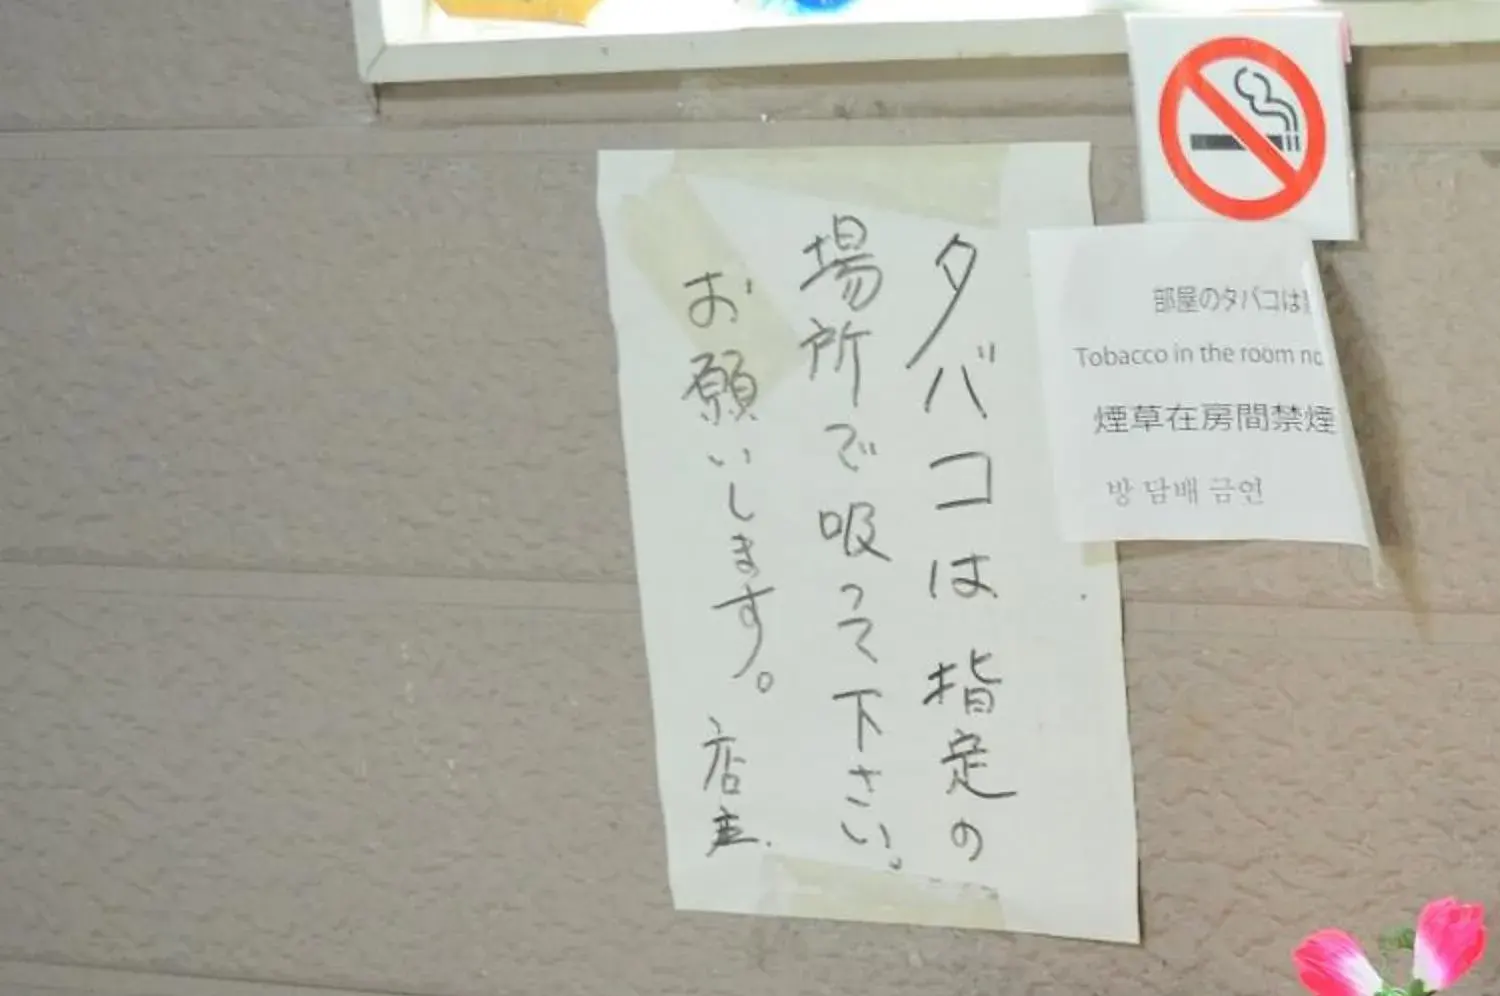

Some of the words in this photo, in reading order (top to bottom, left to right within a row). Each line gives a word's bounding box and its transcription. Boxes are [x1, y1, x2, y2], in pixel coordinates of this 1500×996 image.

[1152, 285, 1310, 314] 部屋のタバコは
[1074, 346, 1168, 368] Tobacco
[1174, 342, 1194, 365] in
[1200, 343, 1234, 365] the
[1240, 349, 1295, 365] room
[1106, 476, 1134, 507] 방
[1143, 476, 1199, 507] 담배
[1209, 476, 1265, 506] 금연
